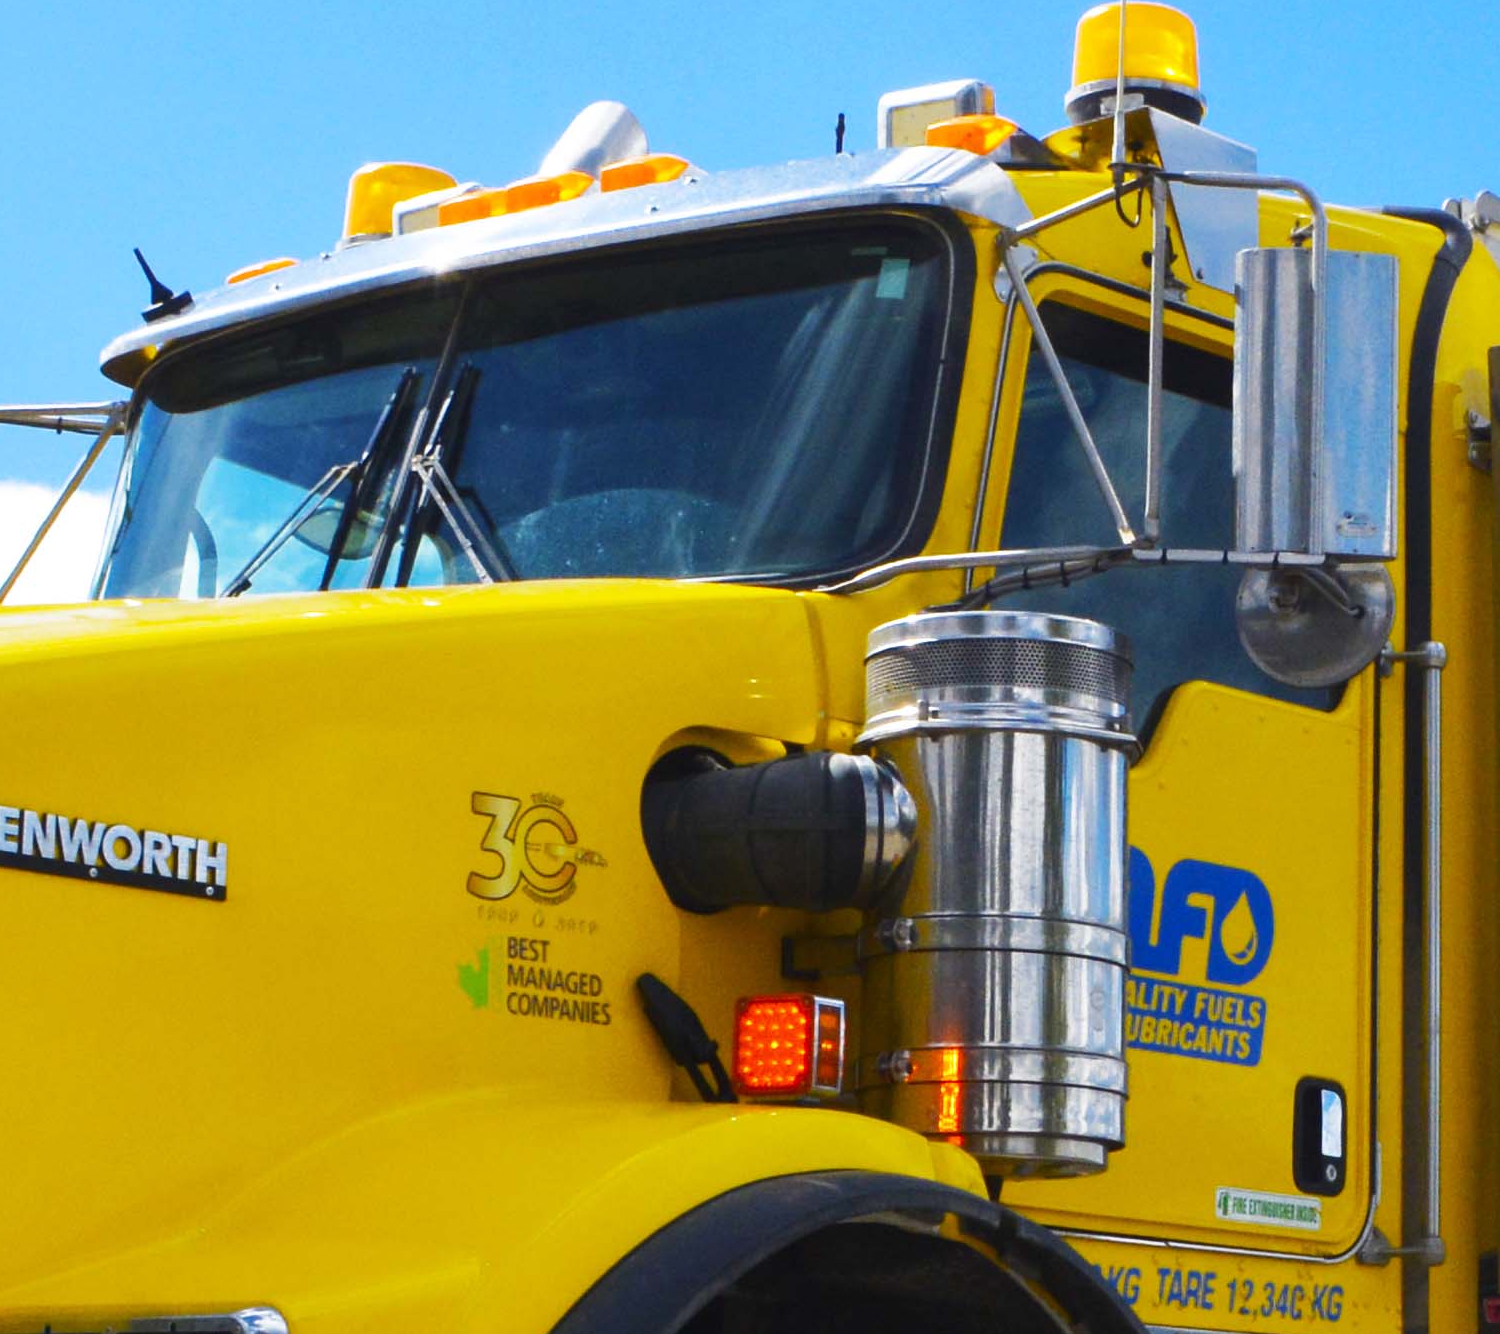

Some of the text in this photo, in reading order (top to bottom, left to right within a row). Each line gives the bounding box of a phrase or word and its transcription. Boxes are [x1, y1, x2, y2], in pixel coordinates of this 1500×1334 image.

[506, 936, 550, 964] BEST
[506, 964, 604, 998] MANAGED
[506, 992, 612, 1027] COMPANIES
[1126, 979, 1262, 1029] ALITY FUELS
[1125, 1012, 1252, 1060] UBRICANTS
[1157, 1266, 1217, 1310] TARE
[1311, 1283, 1344, 1322] KG
